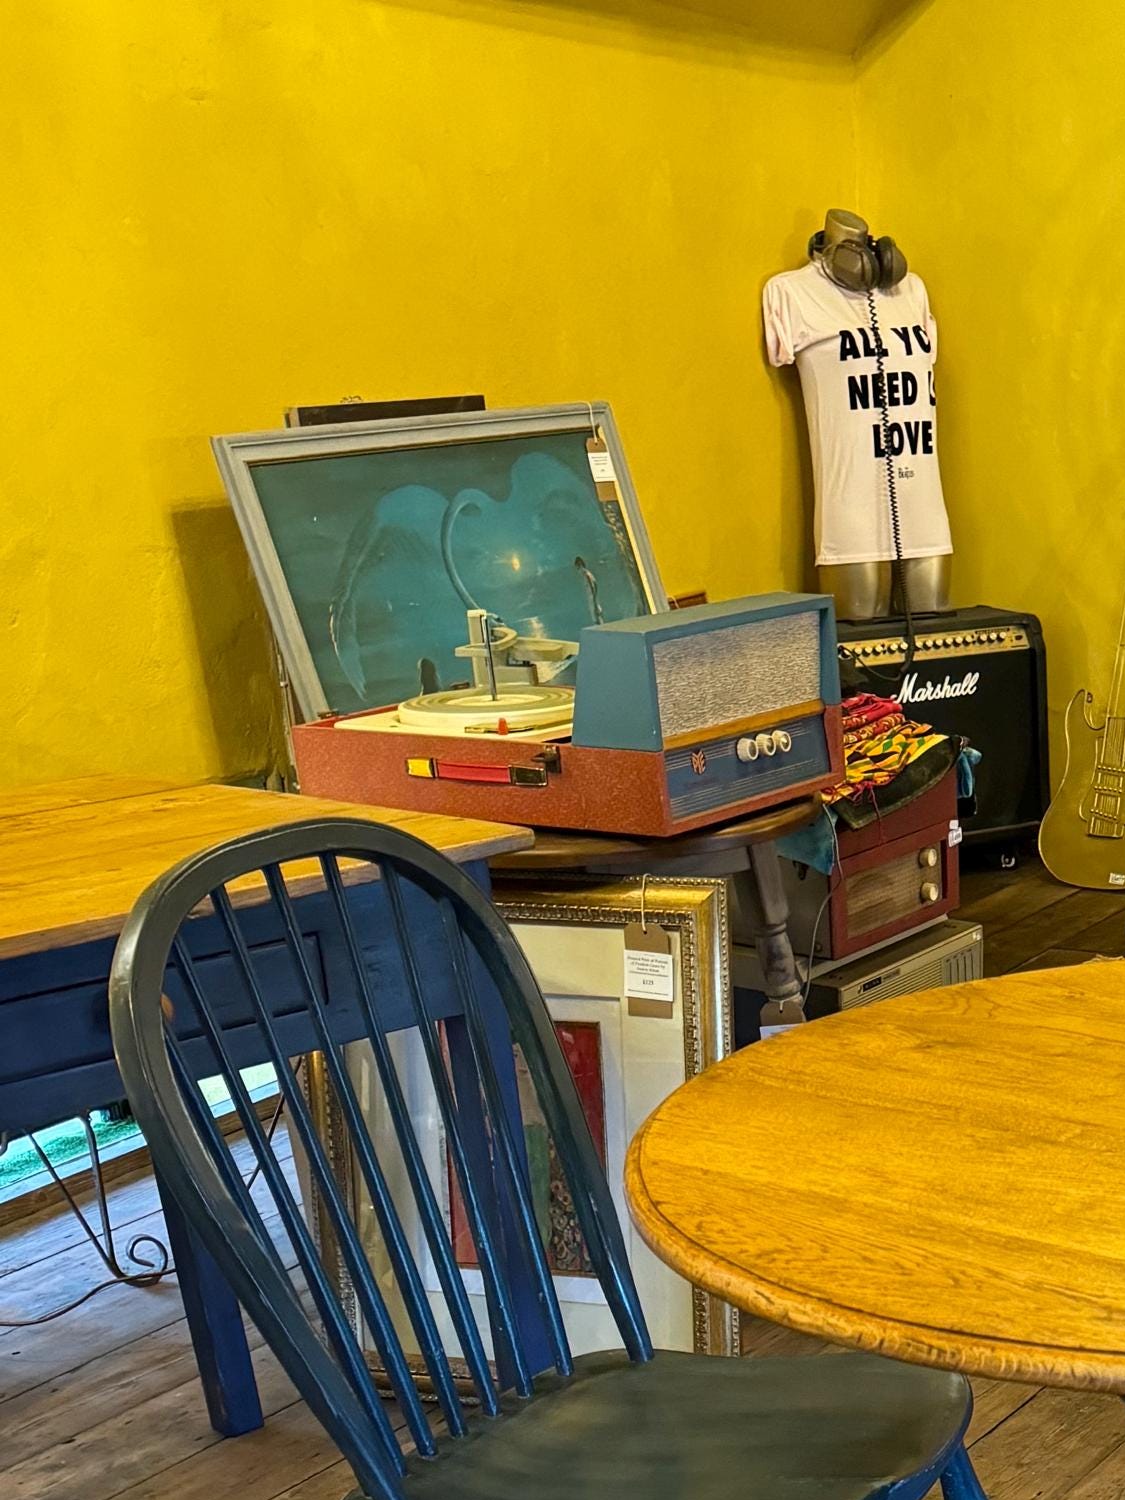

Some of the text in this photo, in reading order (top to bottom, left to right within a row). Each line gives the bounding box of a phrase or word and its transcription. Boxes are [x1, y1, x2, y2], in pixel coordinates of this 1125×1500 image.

[839, 327, 889, 361] ALL
[848, 371, 918, 410] NEED
[872, 420, 933, 458] LOVE
[893, 672, 980, 704] Marshall
